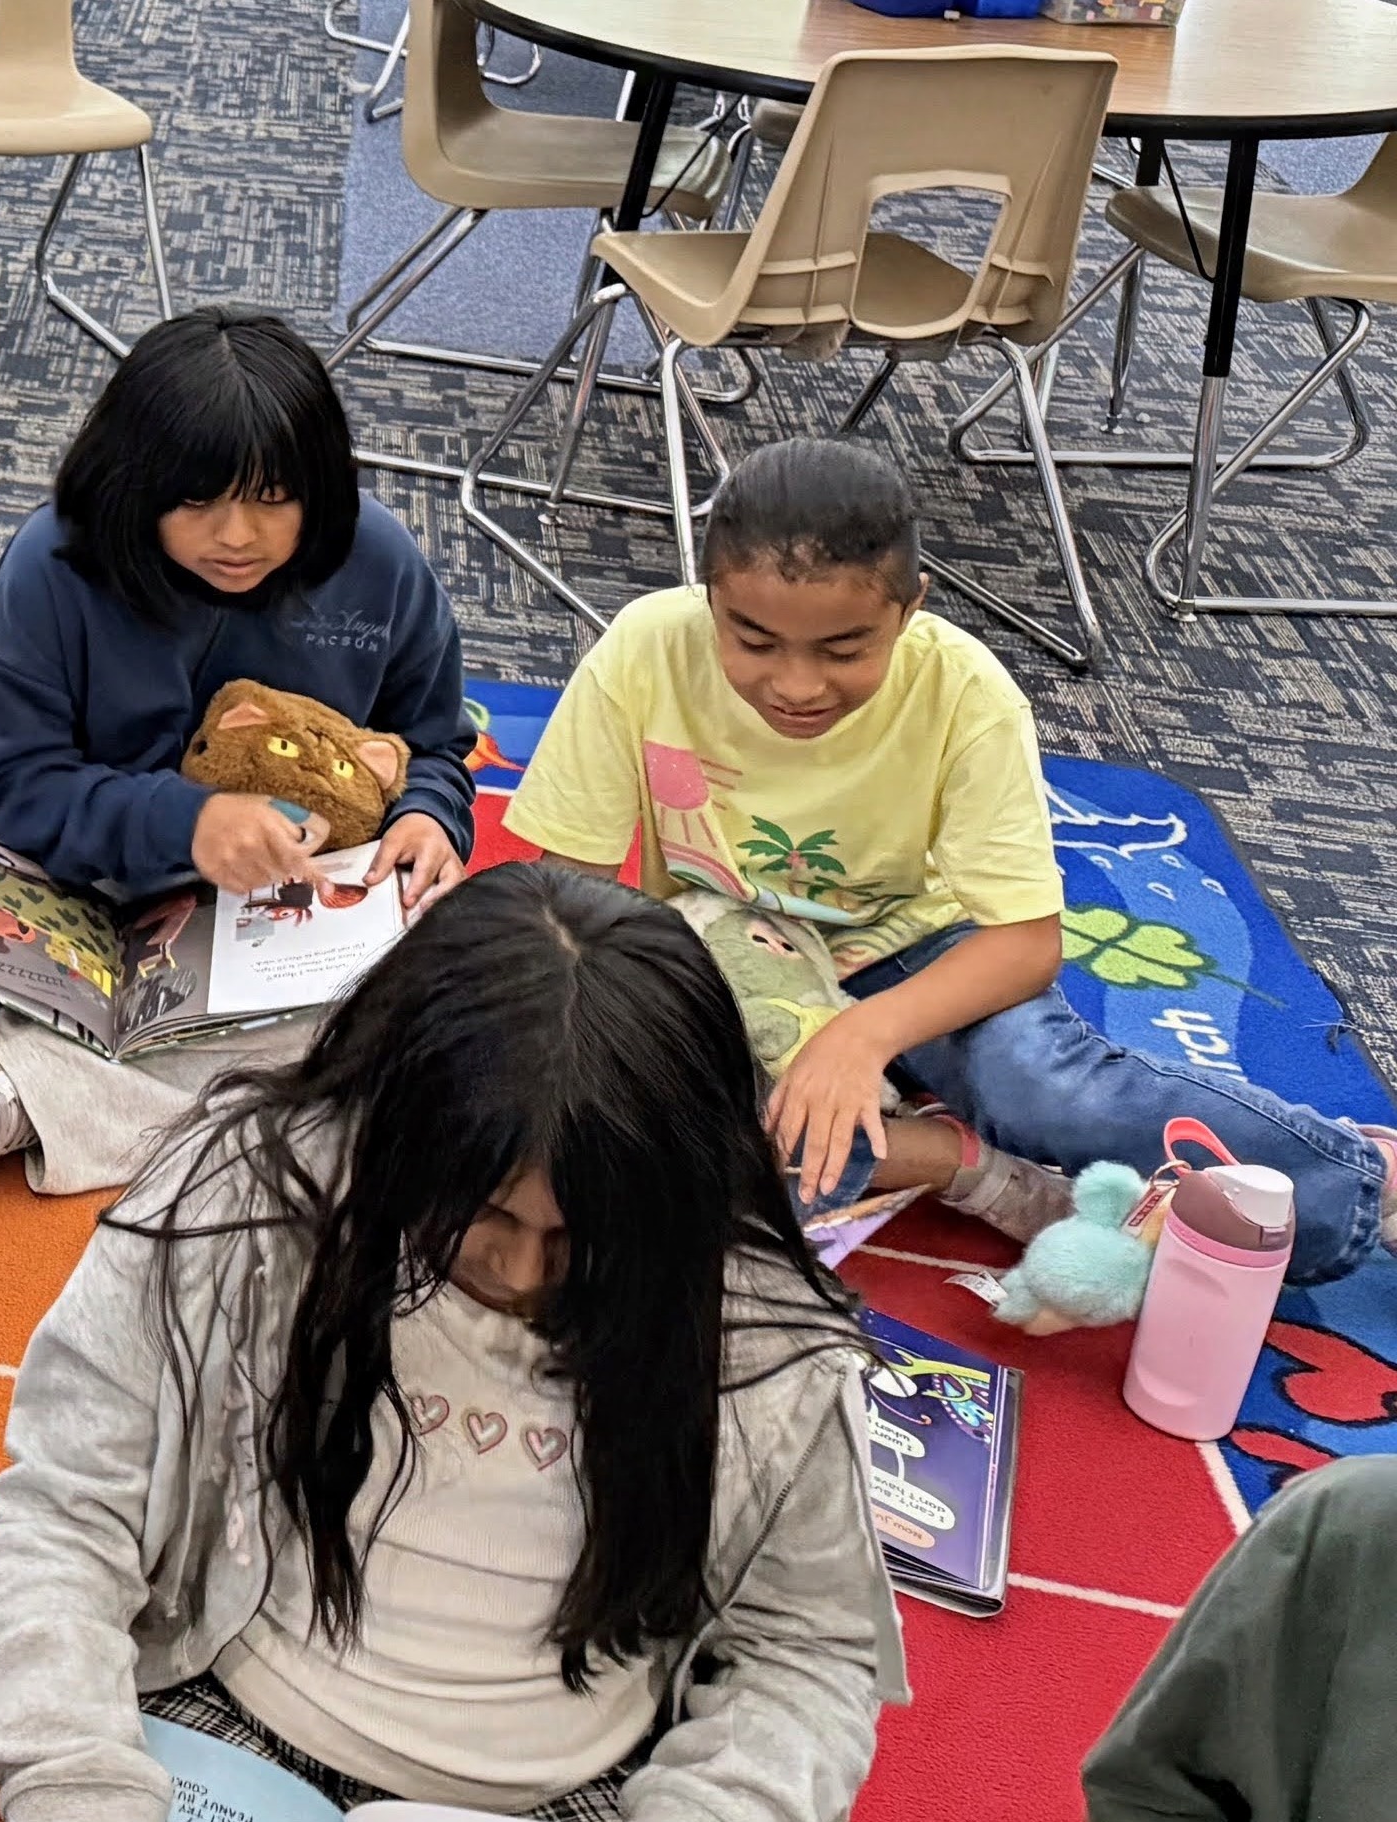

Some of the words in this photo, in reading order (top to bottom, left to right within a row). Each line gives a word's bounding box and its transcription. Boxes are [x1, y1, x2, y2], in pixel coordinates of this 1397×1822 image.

[306, 632, 379, 653] PACSUN
[1149, 1007, 1248, 1083] rch
[873, 1475, 905, 1496] have
